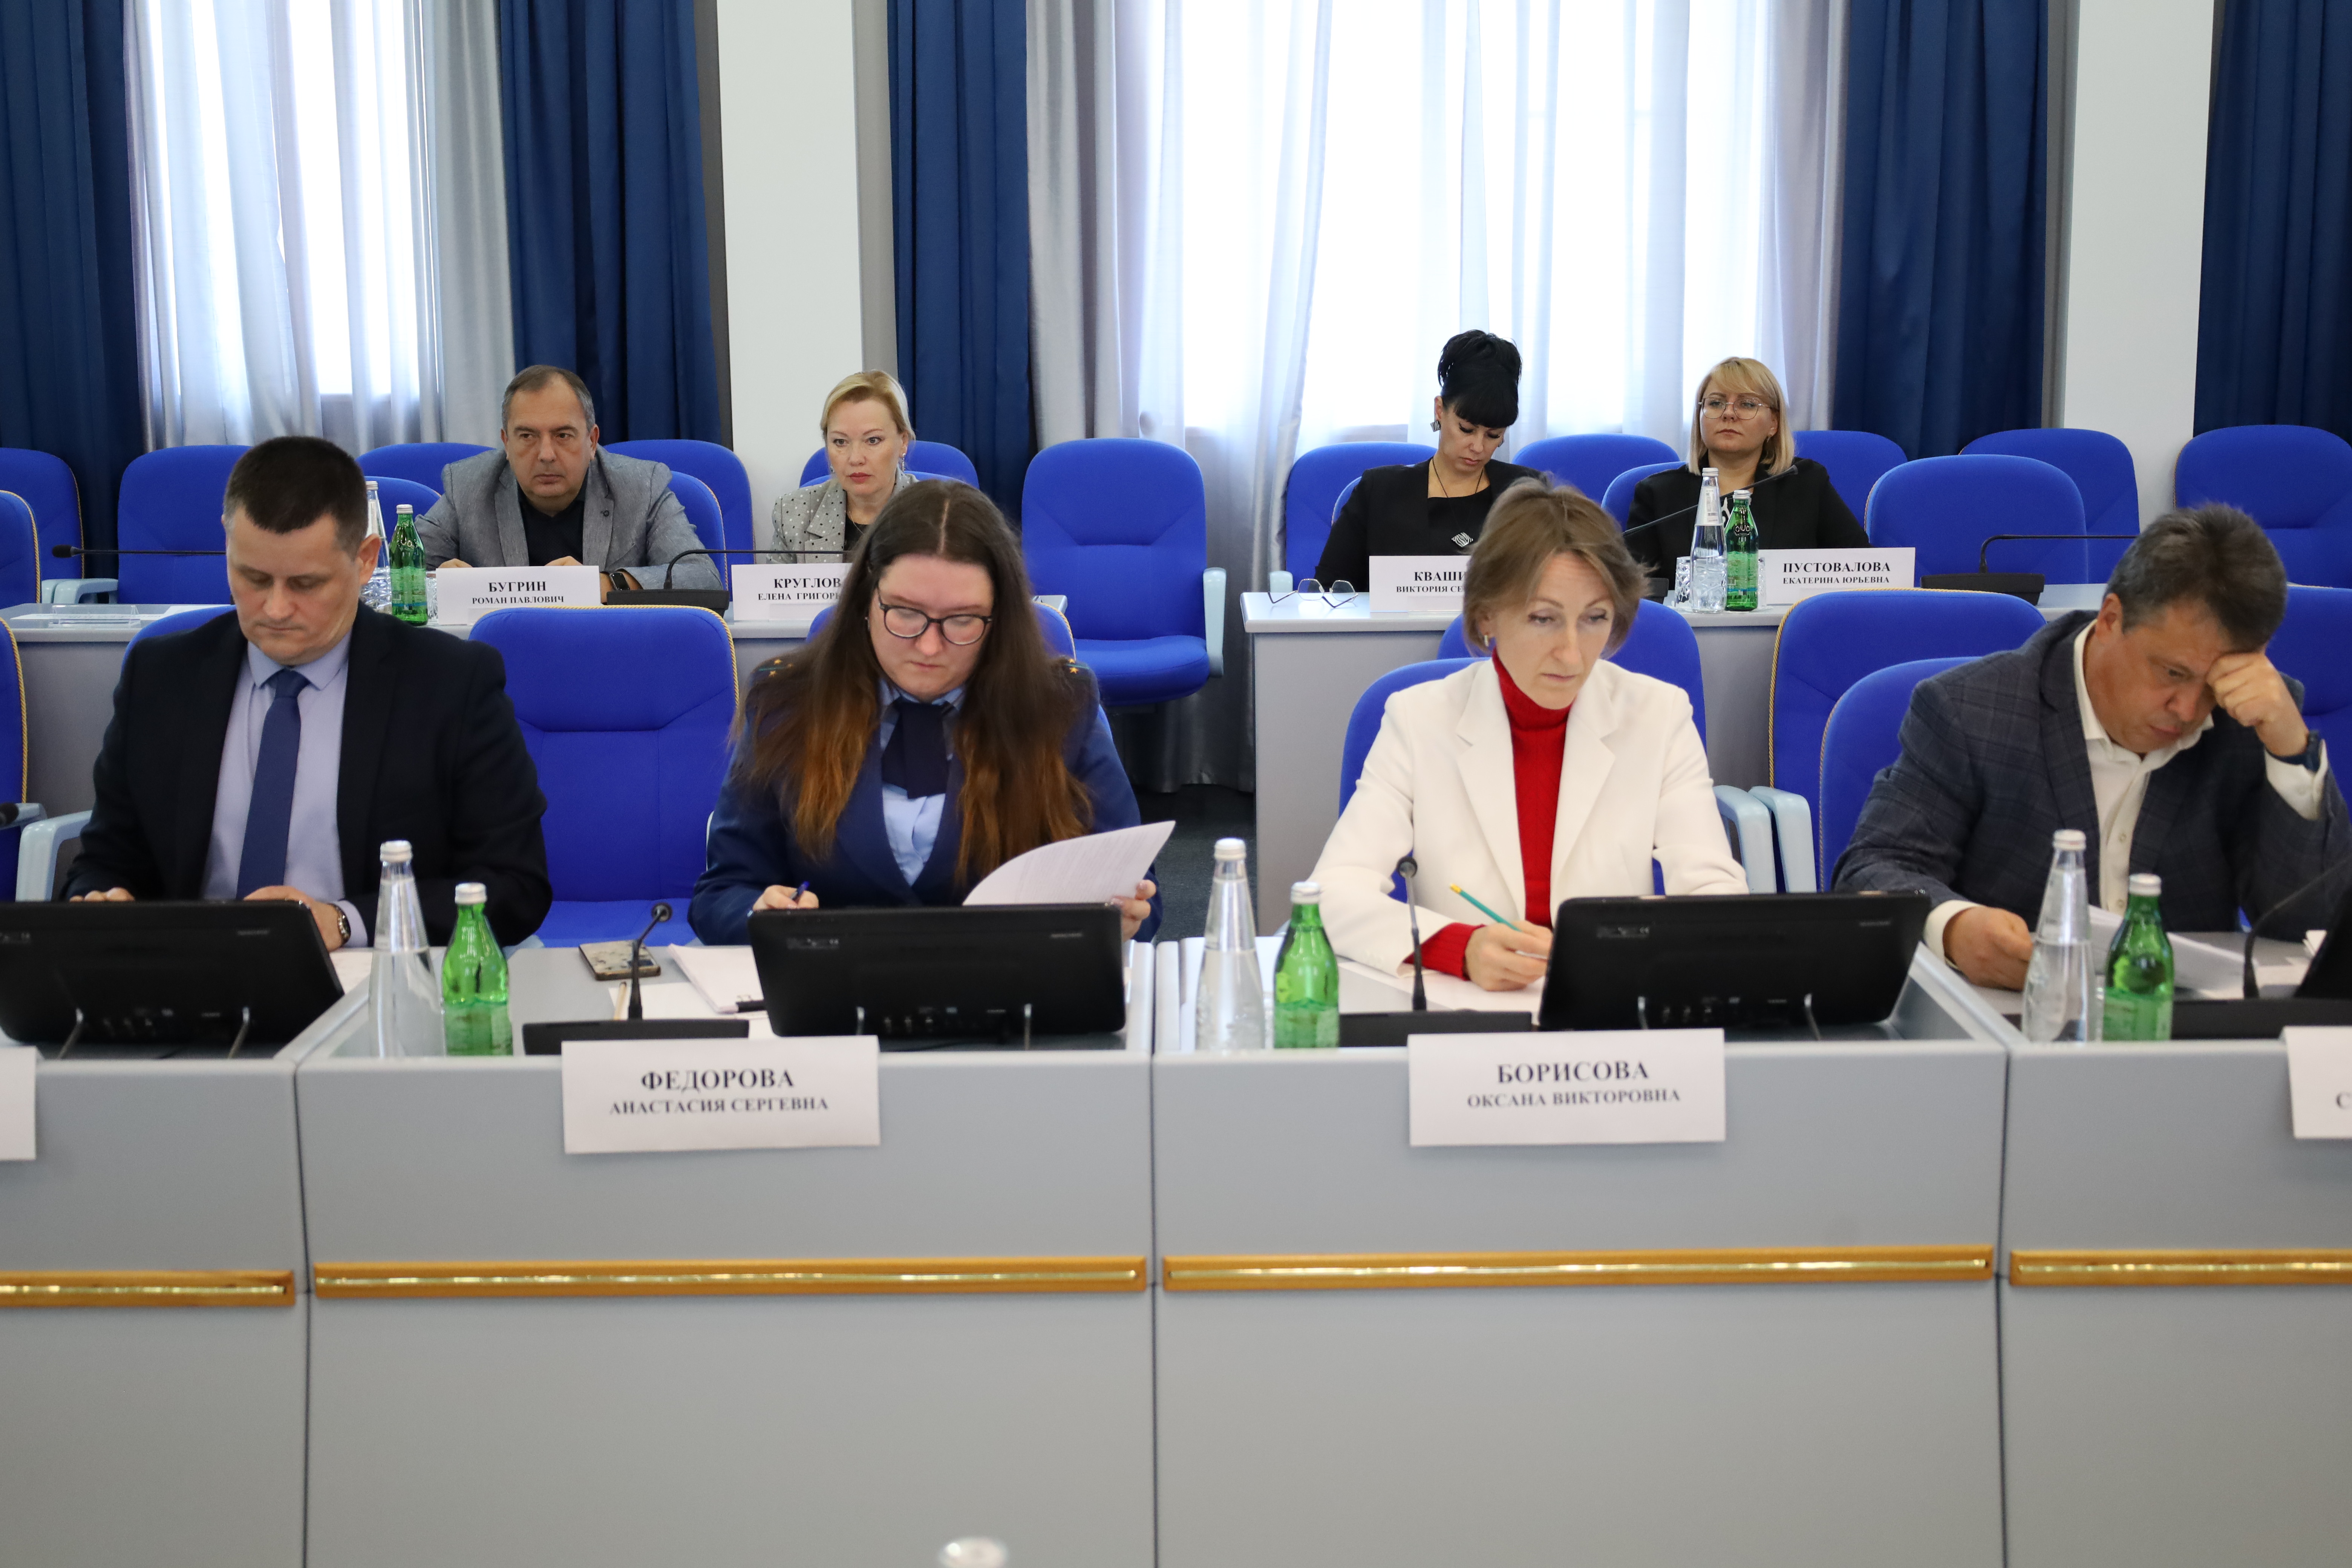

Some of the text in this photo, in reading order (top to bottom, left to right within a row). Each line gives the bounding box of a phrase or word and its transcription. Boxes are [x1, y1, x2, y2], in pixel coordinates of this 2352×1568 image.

[1783, 562, 1891, 573] ПУСТОВАЛОВА
[488, 581, 547, 592] БУГРИН
[640, 1068, 795, 1093] ФЕДОРОВА
[1497, 1060, 1649, 1084] БОРИСОВА
[610, 1096, 829, 1115] АНАСТАСИЯ СЕРГЕВНА
[1466, 1088, 1681, 1109] ОКСАНА ВИКТОРОВНА
